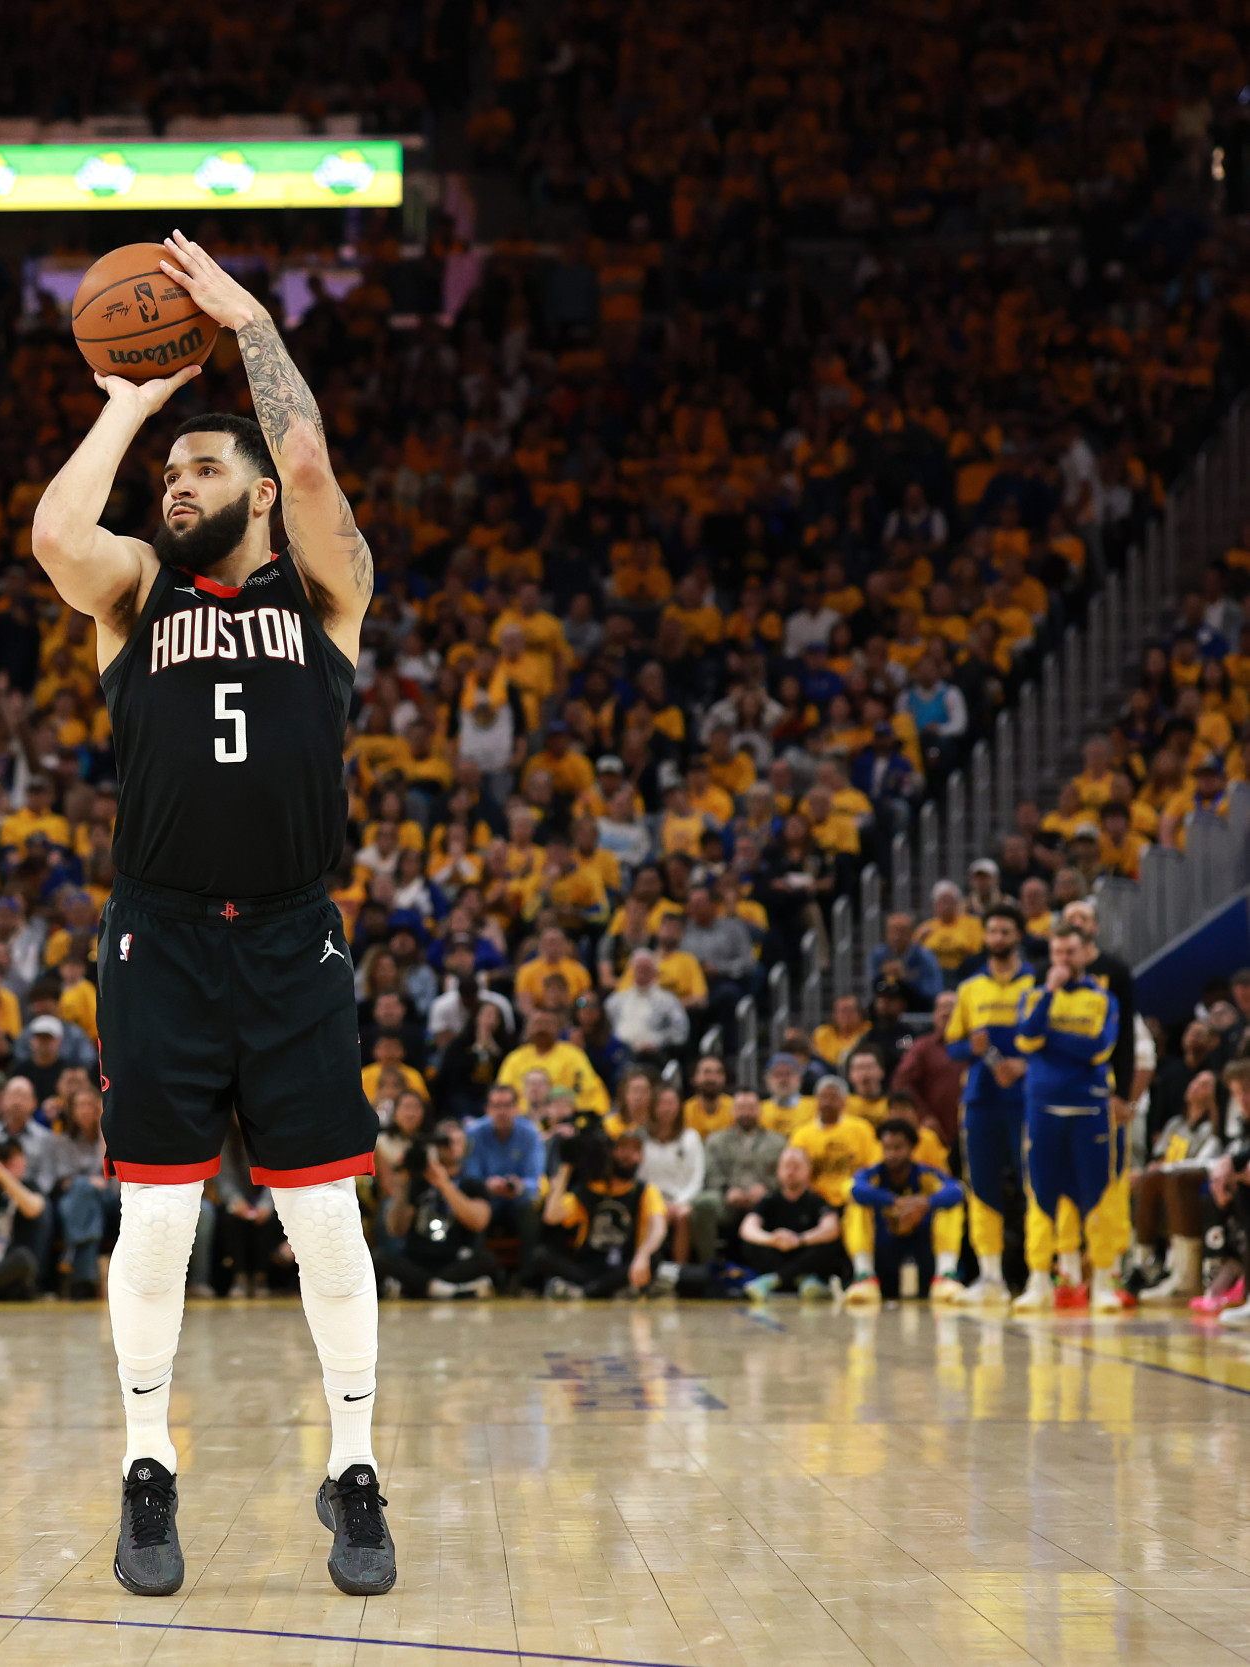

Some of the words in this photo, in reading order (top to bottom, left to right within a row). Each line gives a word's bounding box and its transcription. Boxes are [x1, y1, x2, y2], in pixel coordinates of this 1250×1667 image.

[108, 327, 205, 366] Wilson
[150, 605, 307, 675] HOUSTON
[213, 682, 248, 763] 5
